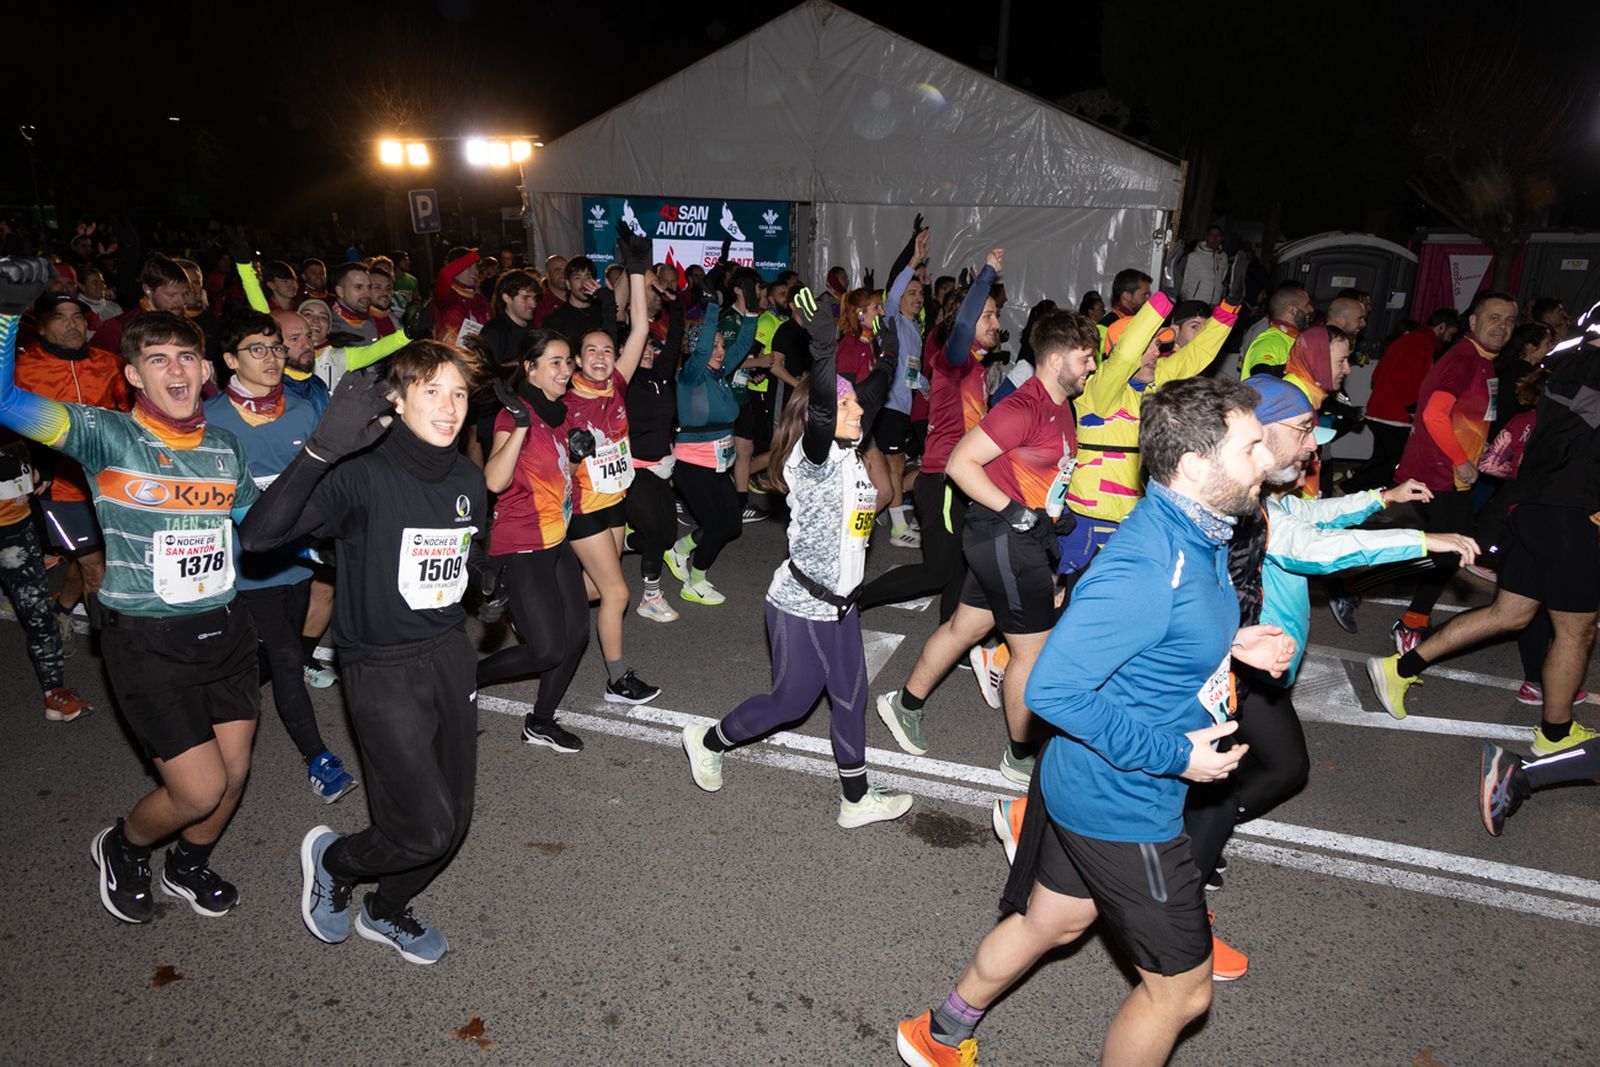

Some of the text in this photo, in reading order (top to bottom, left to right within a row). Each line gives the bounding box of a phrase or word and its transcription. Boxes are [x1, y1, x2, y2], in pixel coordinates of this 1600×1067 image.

[416, 195, 432, 228] P
[660, 204, 709, 221] 43 SAN
[656, 218, 707, 237] ANTÓN
[727, 224, 738, 235] 43
[704, 257, 719, 268] SA
[600, 457, 627, 479] 7445
[177, 536, 216, 546] NOCHE DE
[424, 538, 447, 546] NOCHE
[165, 544, 215, 556] SAN ANTÓN
[412, 548, 429, 557] SAN
[177, 551, 224, 578] 1378
[418, 556, 462, 581] 1509
